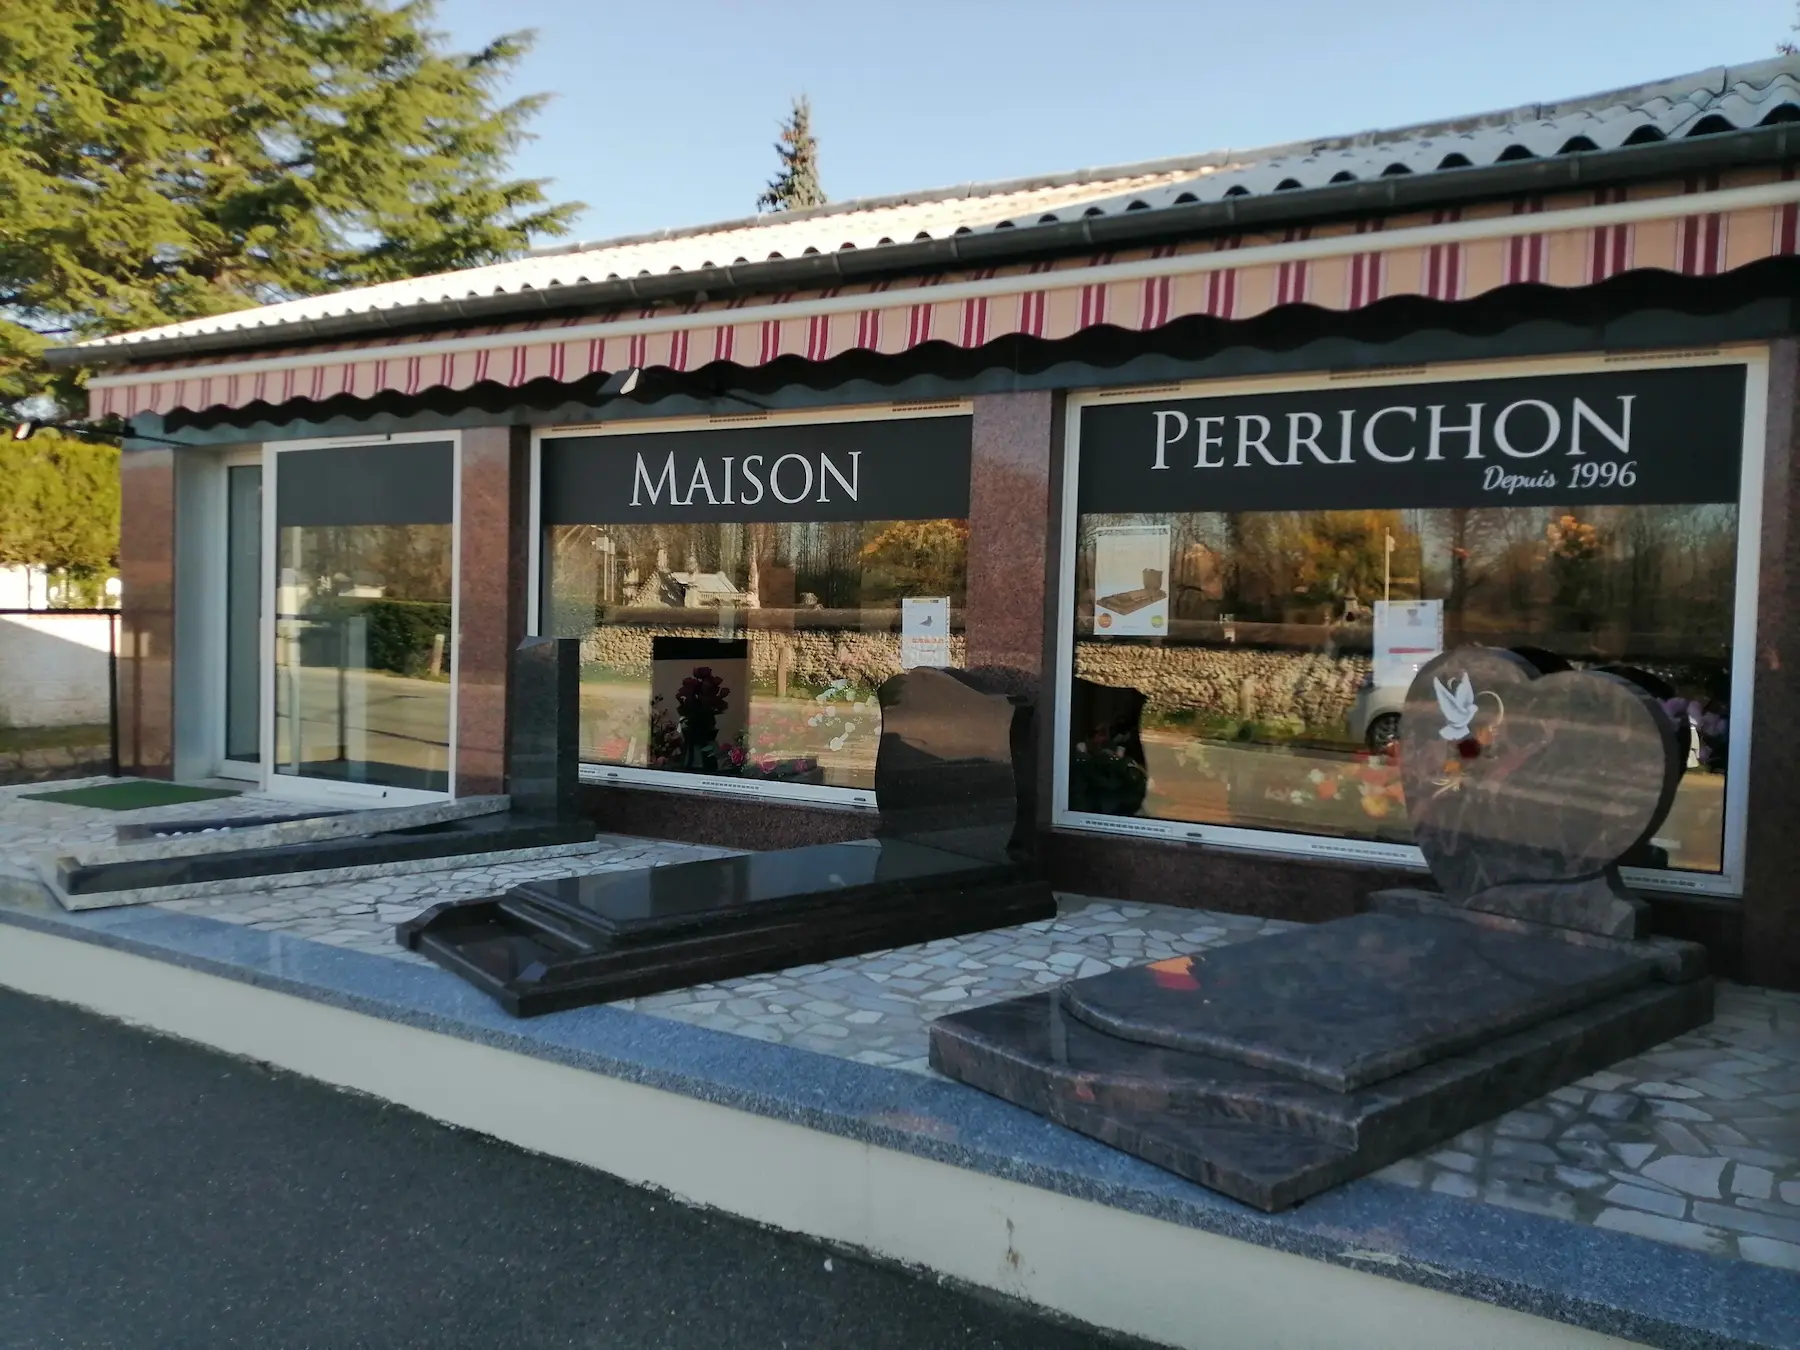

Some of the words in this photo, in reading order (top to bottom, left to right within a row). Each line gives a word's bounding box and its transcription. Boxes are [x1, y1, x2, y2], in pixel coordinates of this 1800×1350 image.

[1150, 395, 1637, 470] PERRICHON
[629, 450, 862, 507] MAISON
[1482, 465, 1559, 495] Depuis
[1567, 460, 1637, 488] 1996
